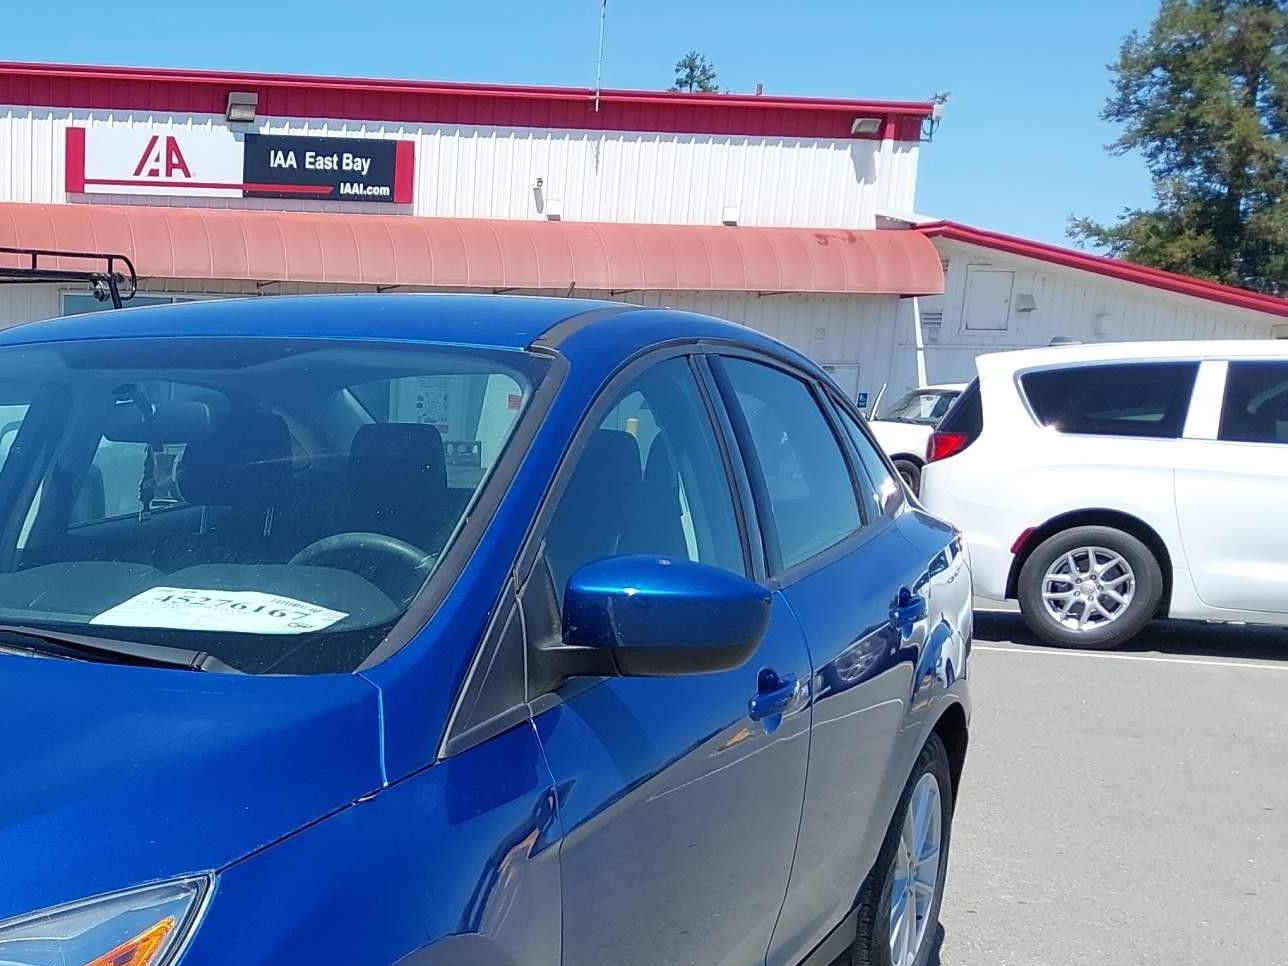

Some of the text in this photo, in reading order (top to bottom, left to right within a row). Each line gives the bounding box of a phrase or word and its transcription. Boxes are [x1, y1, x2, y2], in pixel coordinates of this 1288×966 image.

[270, 150, 371, 175] IAA East Bay
[340, 182, 390, 196] IAAI.com
